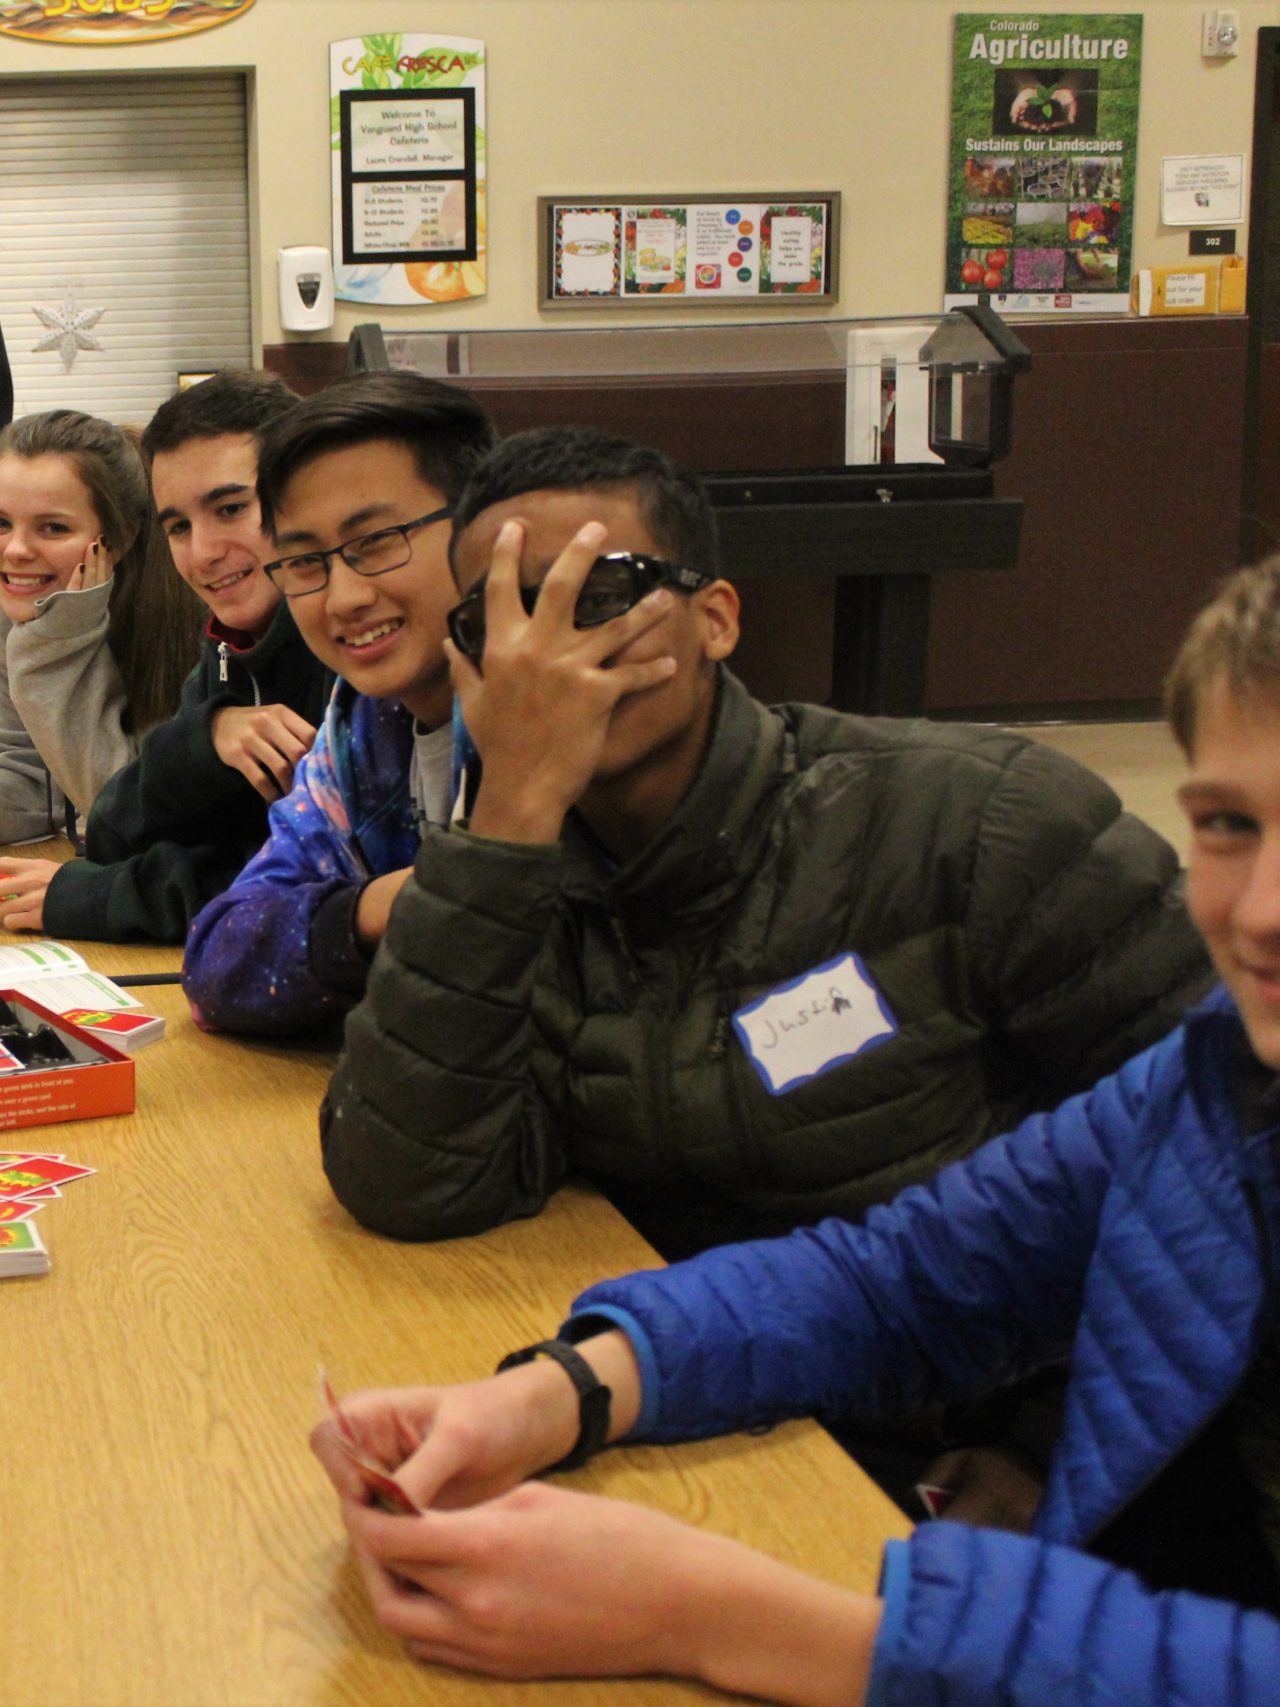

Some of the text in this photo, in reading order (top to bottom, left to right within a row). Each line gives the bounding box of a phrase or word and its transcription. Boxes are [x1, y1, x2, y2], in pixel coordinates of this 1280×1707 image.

[990, 20, 1039, 31] Colorado
[969, 32, 1128, 65] Agriculture
[396, 55, 465, 74] FRESCA
[381, 109, 436, 120] Welcome To
[361, 120, 457, 136] Vanguard High School
[389, 136, 429, 145] Cafeteria
[966, 138, 1123, 153] Sustains Our Landscapes
[1205, 238, 1221, 246] 302
